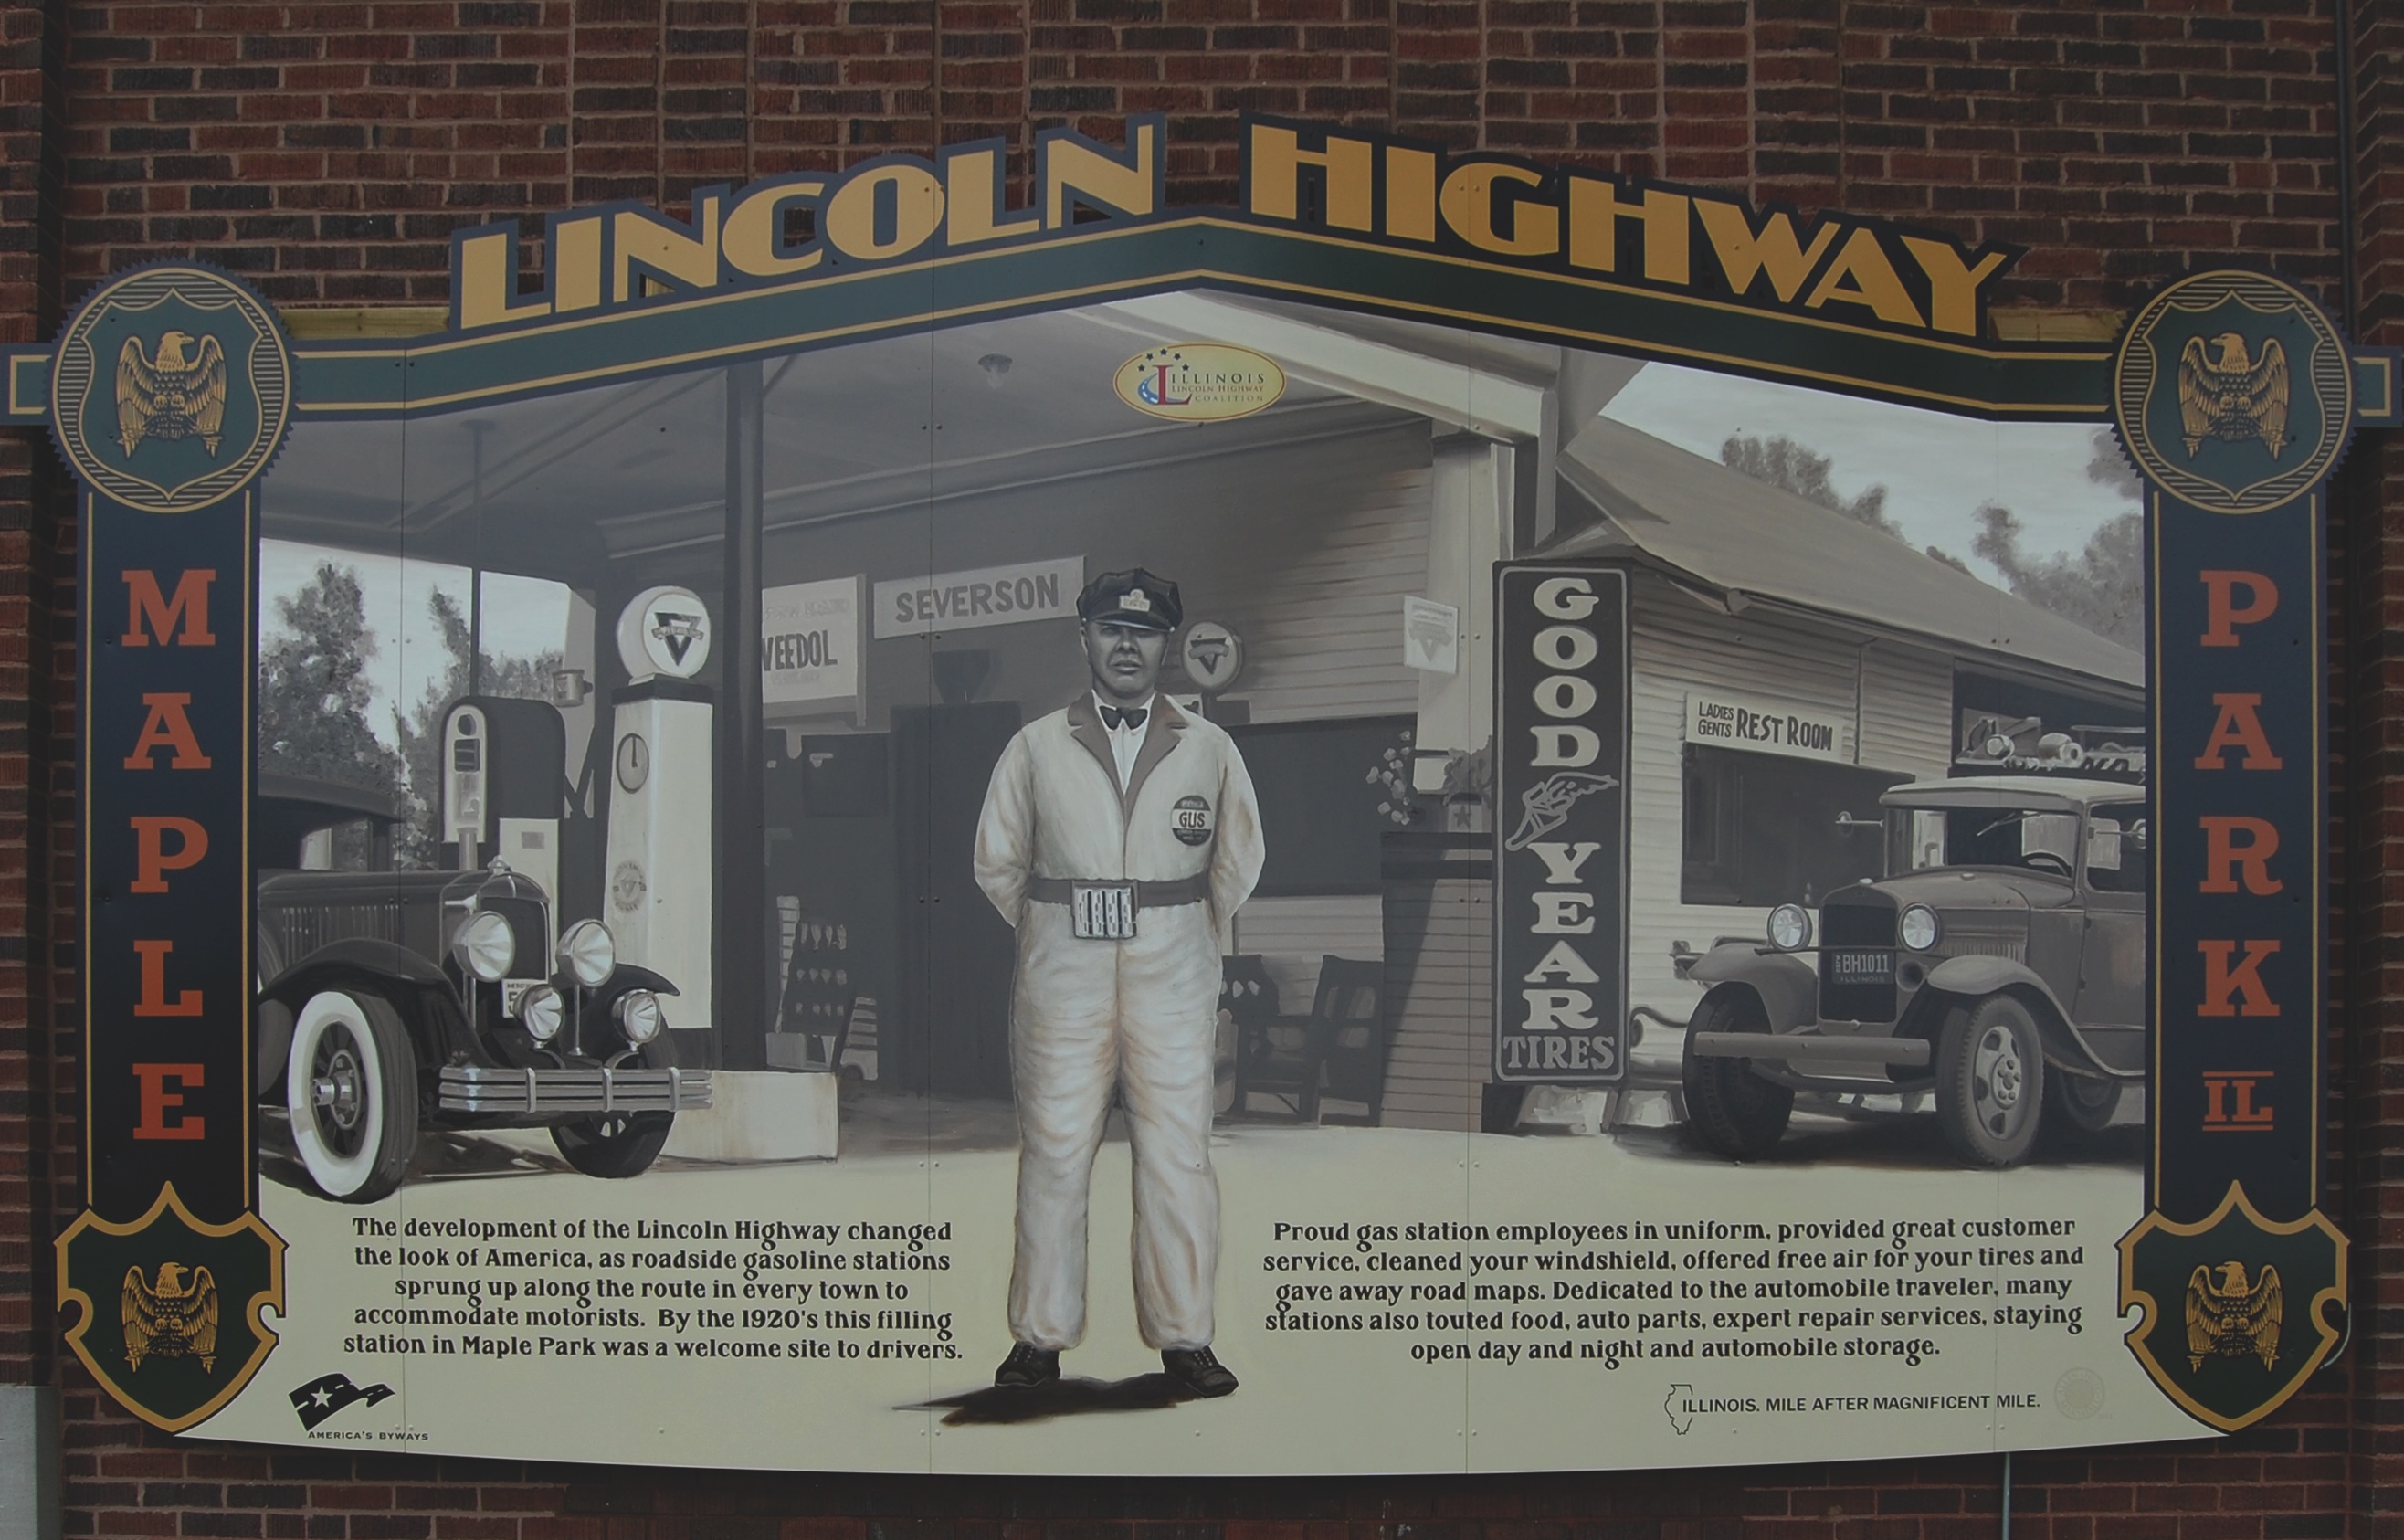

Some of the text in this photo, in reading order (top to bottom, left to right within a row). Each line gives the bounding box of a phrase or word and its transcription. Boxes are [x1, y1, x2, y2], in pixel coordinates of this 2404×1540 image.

[460, 123, 2007, 338] LINCOLN HIGHWAY
[1172, 373, 1265, 385] ILLINOIS
[1195, 395, 1264, 403] COALITION
[895, 573, 1060, 623] SEVERSON
[762, 629, 838, 671] VEEDOL
[1699, 701, 1734, 721] LADIES
[1698, 707, 1834, 752] GENTS REST ROOM
[2194, 570, 2283, 1018] PARK
[1179, 811, 1205, 828] GUS
[121, 569, 216, 1141] MAPLE
[1840, 975, 1886, 984] ILLINOIS
[1842, 954, 1890, 974] BH1011
[1503, 1035, 1616, 1070] TIRES
[2203, 1080, 2273, 1123] IL
[353, 1218, 951, 1253] The development of the Lincoln Highway changed
[1275, 1218, 2074, 1254] Proud gas station employees in uniform, provided great customer
[356, 1248, 949, 1282] the look of America, as roadside gasoline stations
[1264, 1247, 2082, 1276] service, cleaned your windshield, offered free air for your tires and
[395, 1279, 908, 1310] sprung up along the route in every town to
[1276, 1278, 2072, 1312] gave away road maps. Dedicated to the automobile traveler, many
[355, 1306, 952, 1343] accommodate motorists. By the 1920's this filling
[1266, 1305, 2082, 1334] stations also touted food, auto parts, expert repair services, staying
[344, 1334, 962, 1358] station in Maple Park was a welcome site to drivers.
[1411, 1338, 1939, 1370] open day and night and automobile storage.
[1683, 1395, 2040, 1412] ILLINOIS. MILE AFTER MAGNIFICENT MILE.
[308, 1430, 428, 1440] AMERICA'S BYWAYS
